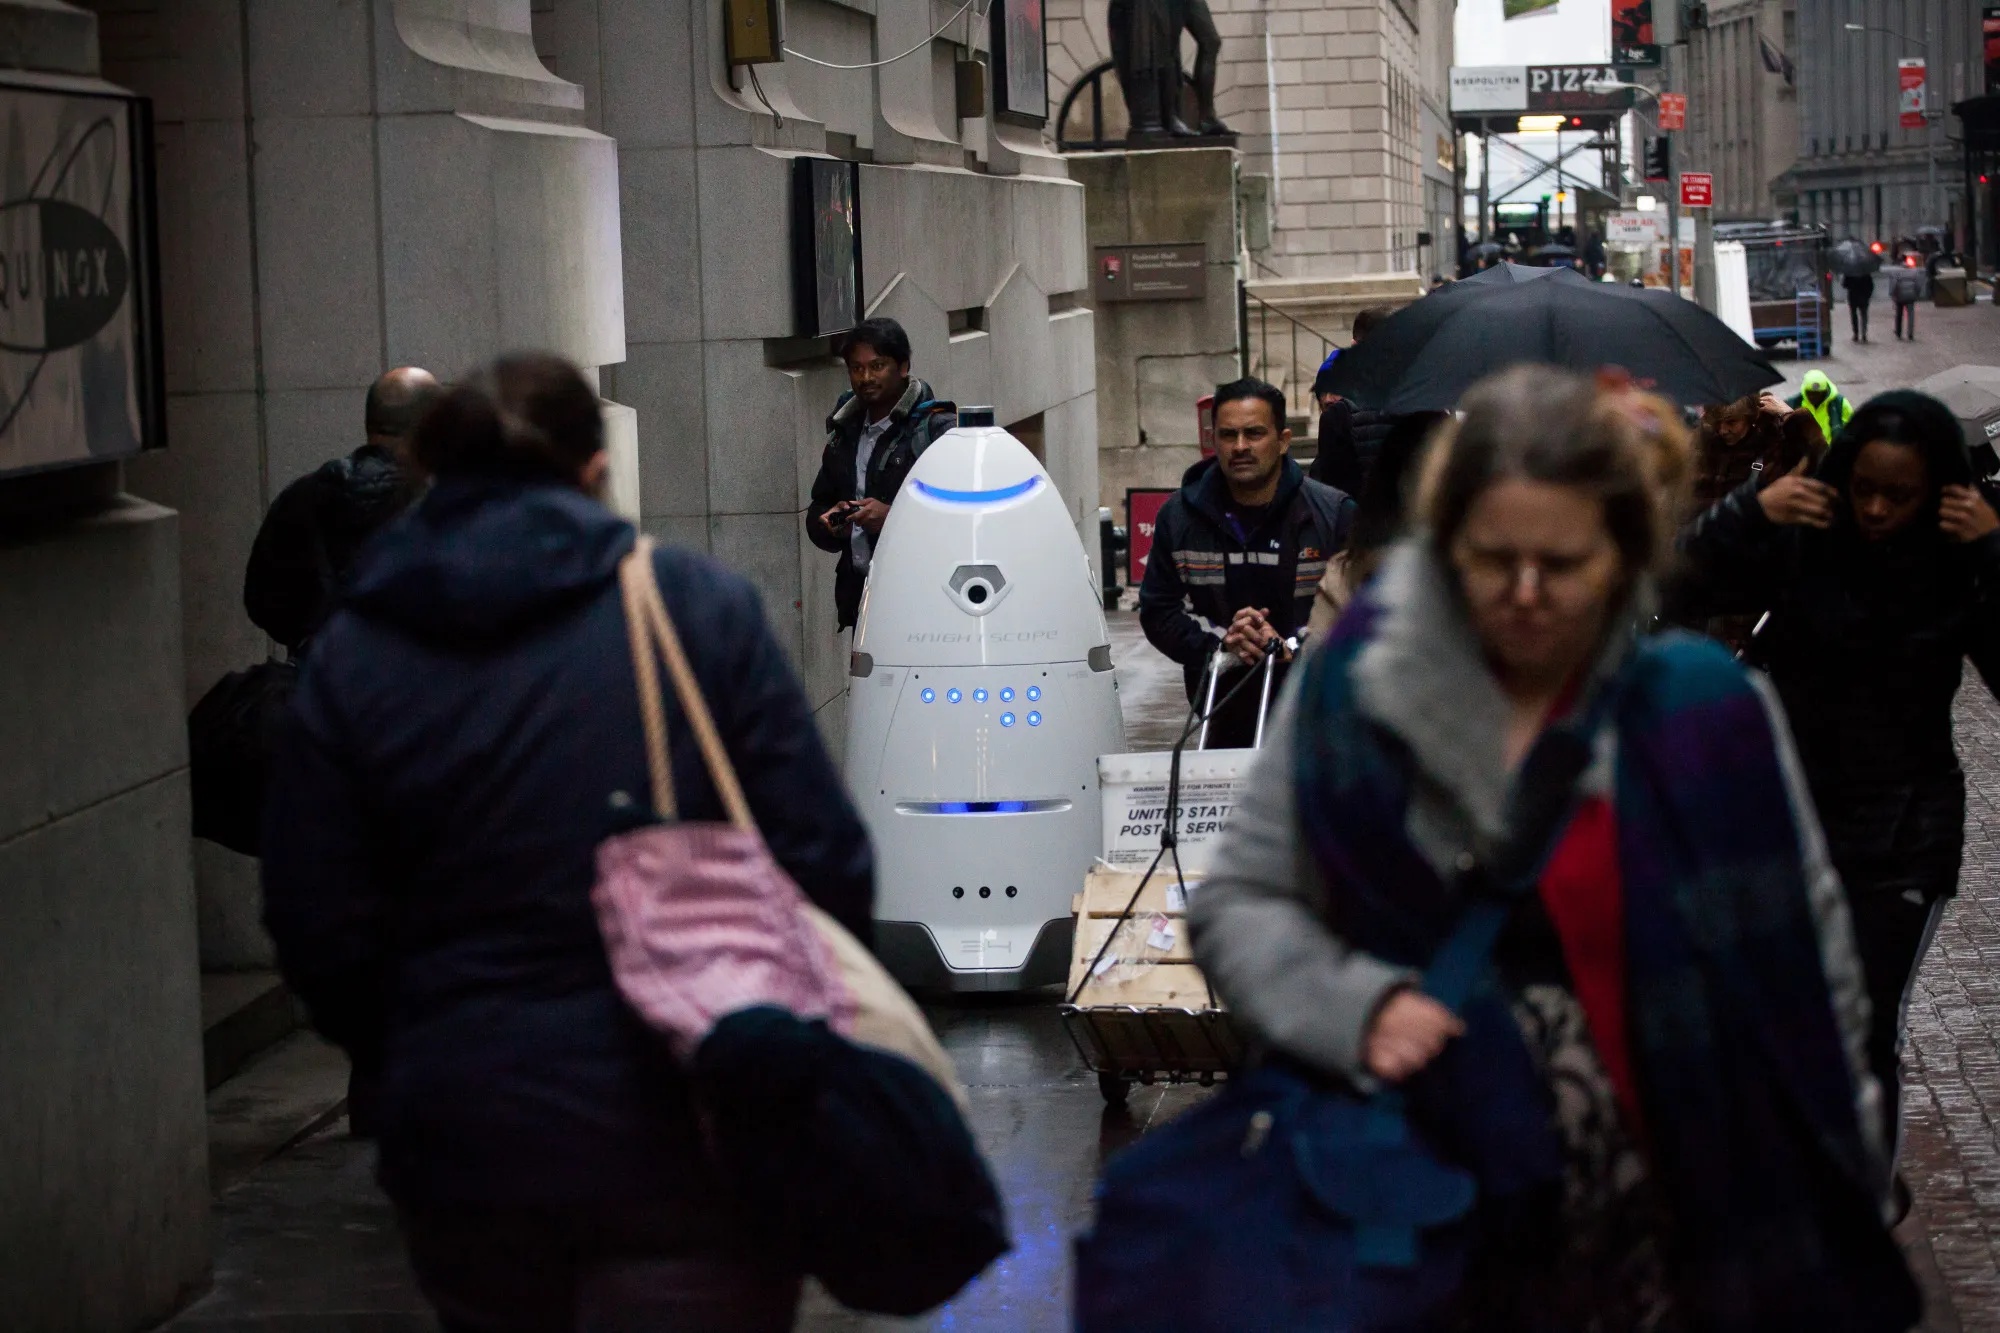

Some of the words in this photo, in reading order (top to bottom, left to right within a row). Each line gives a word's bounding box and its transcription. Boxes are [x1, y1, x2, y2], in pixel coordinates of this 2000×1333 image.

[1531, 66, 1618, 92] PIZZA
[906, 630, 1059, 643] KNIGHTSCOPE
[1120, 823, 1180, 837] POSTL
